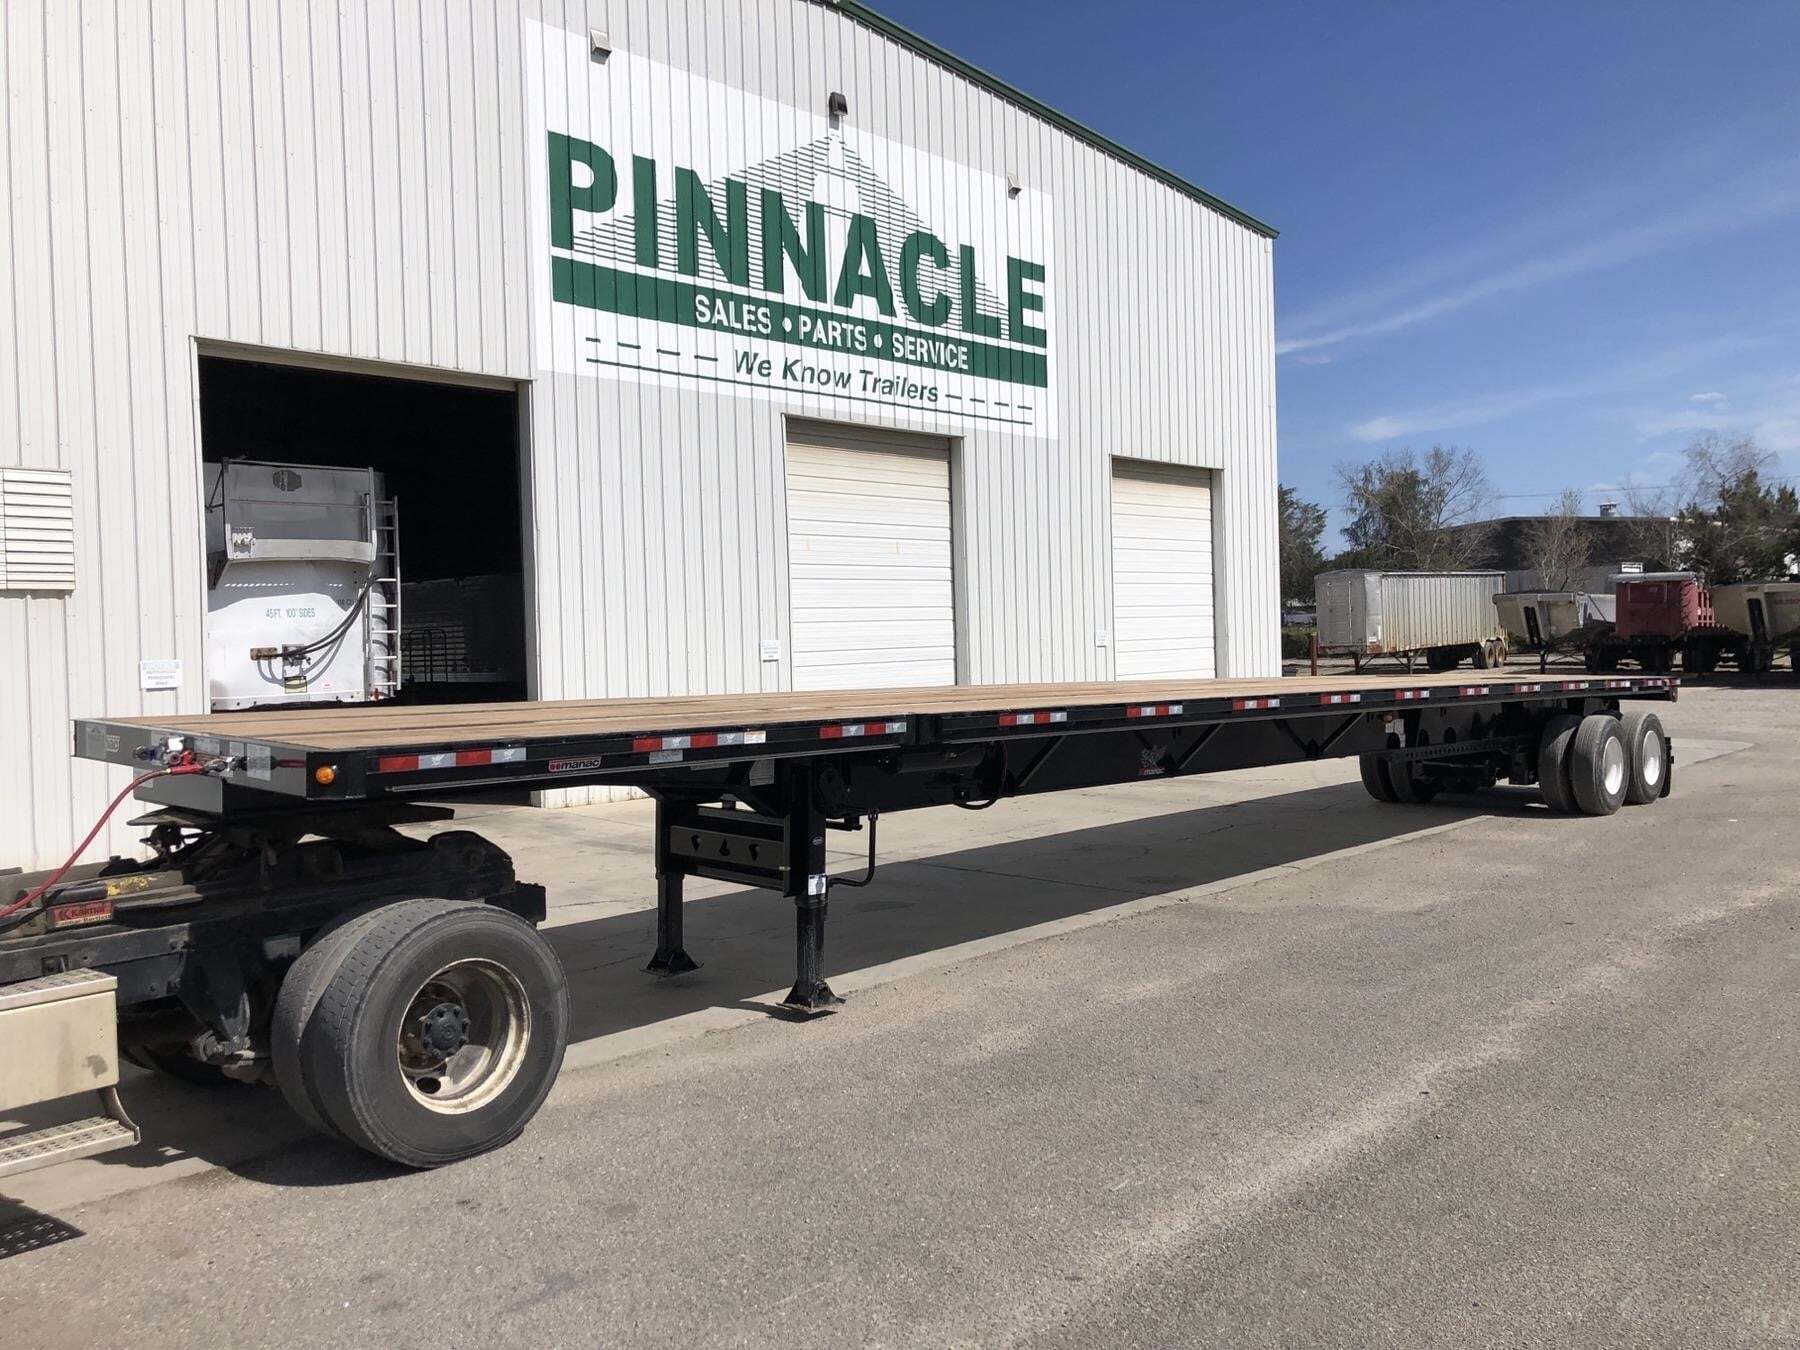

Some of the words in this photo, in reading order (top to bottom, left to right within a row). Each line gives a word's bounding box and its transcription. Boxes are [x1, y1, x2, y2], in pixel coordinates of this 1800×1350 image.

[548, 130, 1047, 349] PINNACLE
[695, 294, 771, 334] SALES
[798, 315, 867, 351] PARTS
[892, 332, 969, 370] SERVICE
[734, 349, 772, 378] We
[782, 357, 852, 387] Know
[859, 368, 939, 403] Trailers
[299, 607, 315, 618] SIDES
[560, 758, 601, 771] manac
